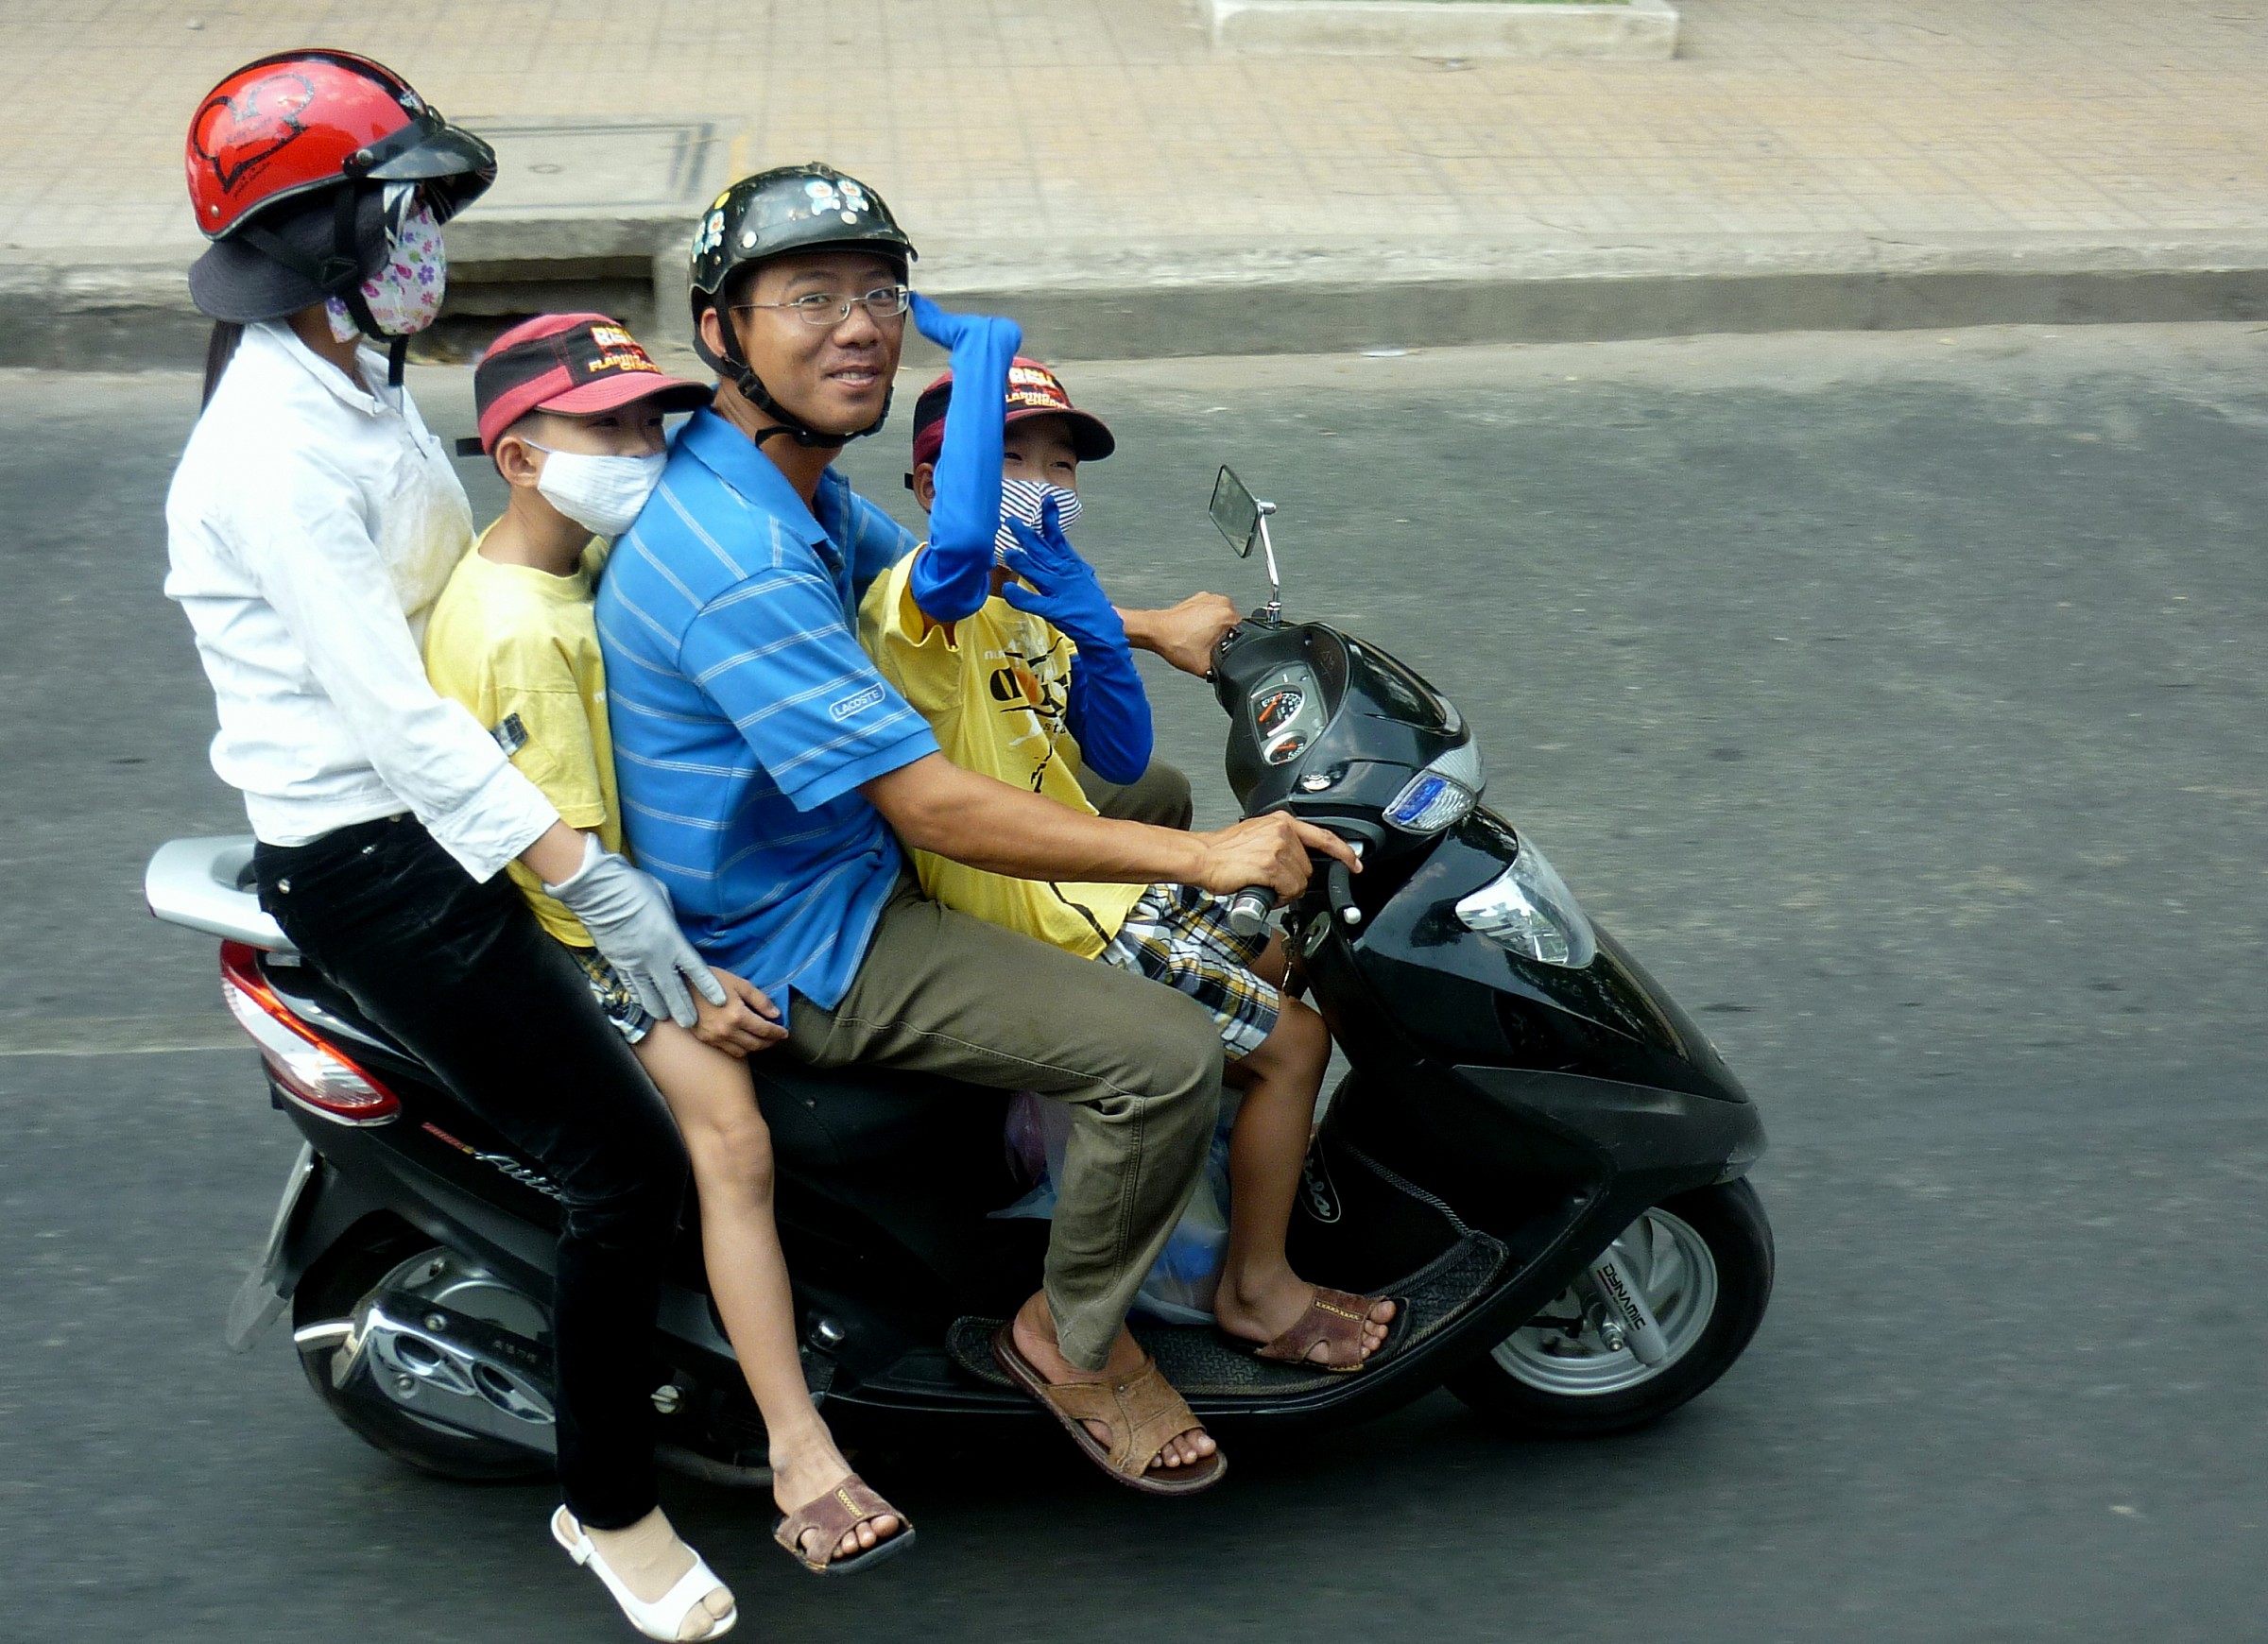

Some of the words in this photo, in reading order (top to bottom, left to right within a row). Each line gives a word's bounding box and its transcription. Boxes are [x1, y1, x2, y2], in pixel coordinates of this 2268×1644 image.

[1005, 391, 1051, 402] LARING
[834, 689, 879, 715] LACOSTE
[1602, 1262, 1647, 1330] DYNAMIC
